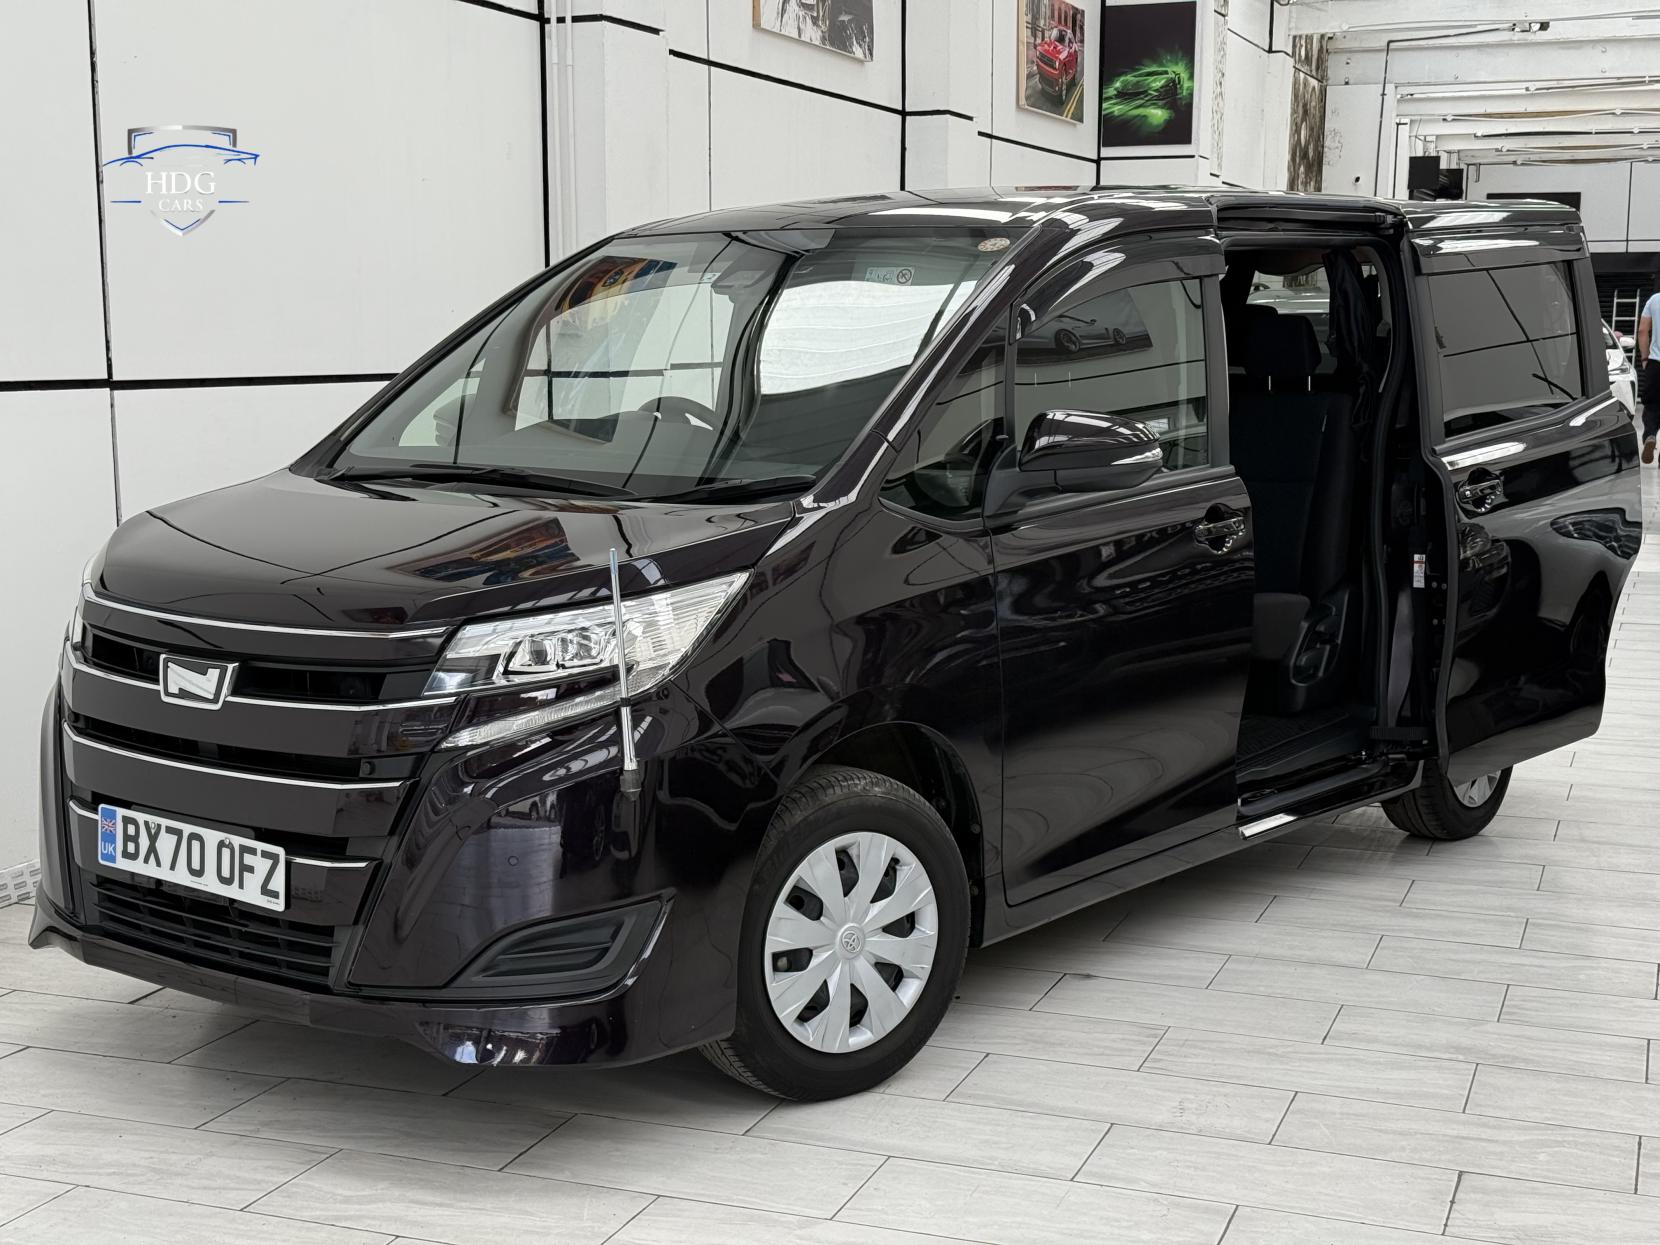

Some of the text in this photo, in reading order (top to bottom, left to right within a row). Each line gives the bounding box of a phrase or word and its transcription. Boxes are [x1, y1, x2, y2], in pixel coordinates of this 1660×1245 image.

[101, 843, 115, 856] UK
[121, 815, 280, 900] BX70 OFZ
